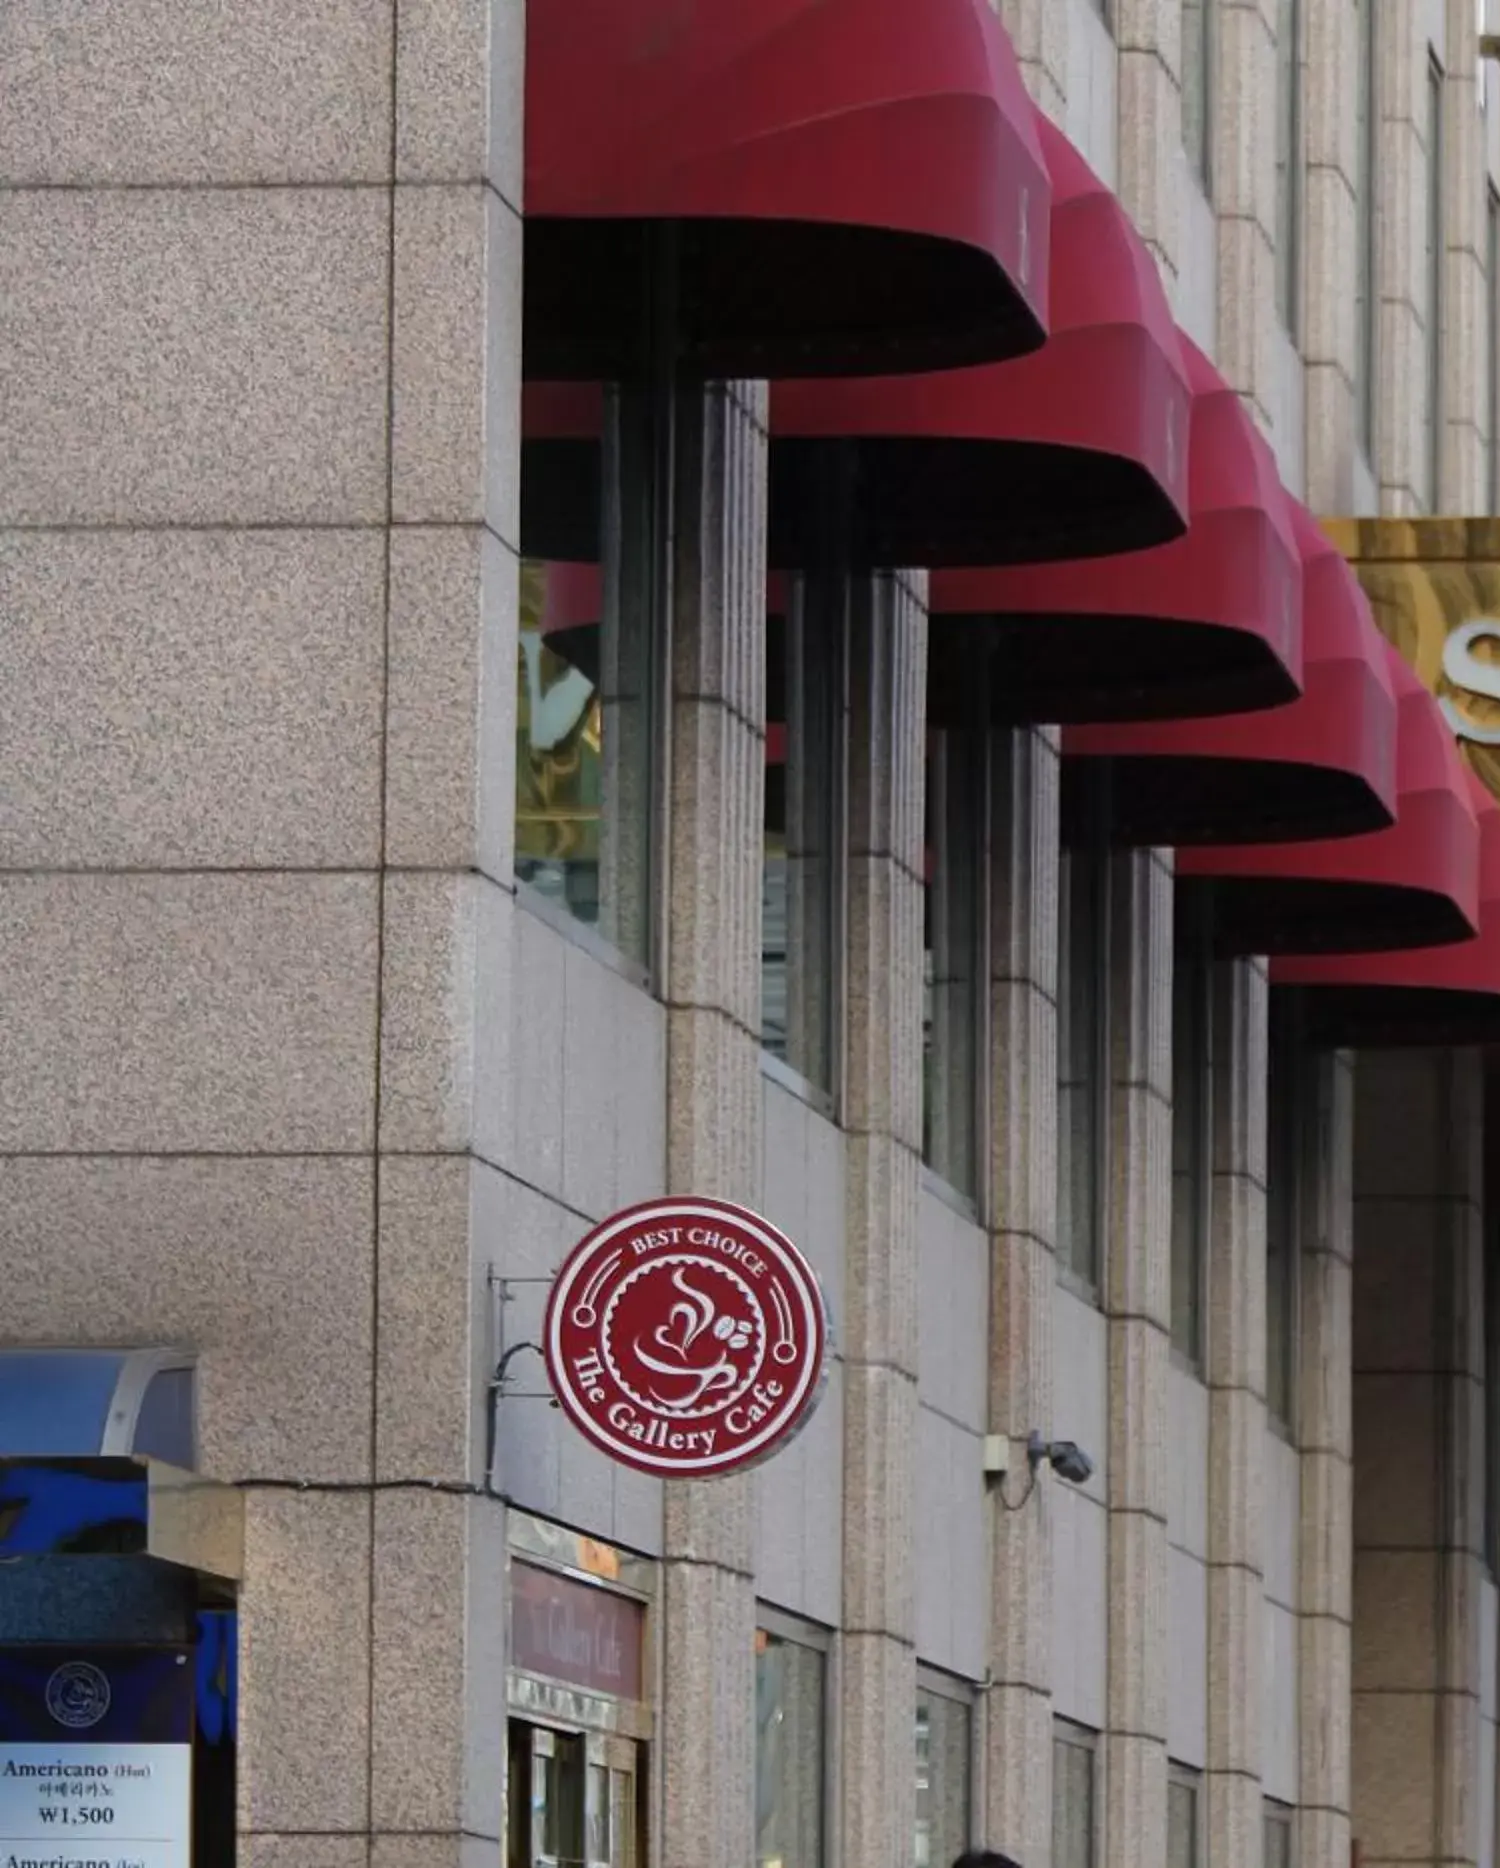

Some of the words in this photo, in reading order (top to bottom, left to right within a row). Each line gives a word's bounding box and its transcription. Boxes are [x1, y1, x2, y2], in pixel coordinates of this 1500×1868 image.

[630, 1228, 683, 1256] BEST
[688, 1228, 768, 1278] CHOICE
[574, 1347, 606, 1404] The
[608, 1402, 716, 1455] Gallery
[724, 1379, 784, 1434] Cafe
[3, 1759, 109, 1778] Americano
